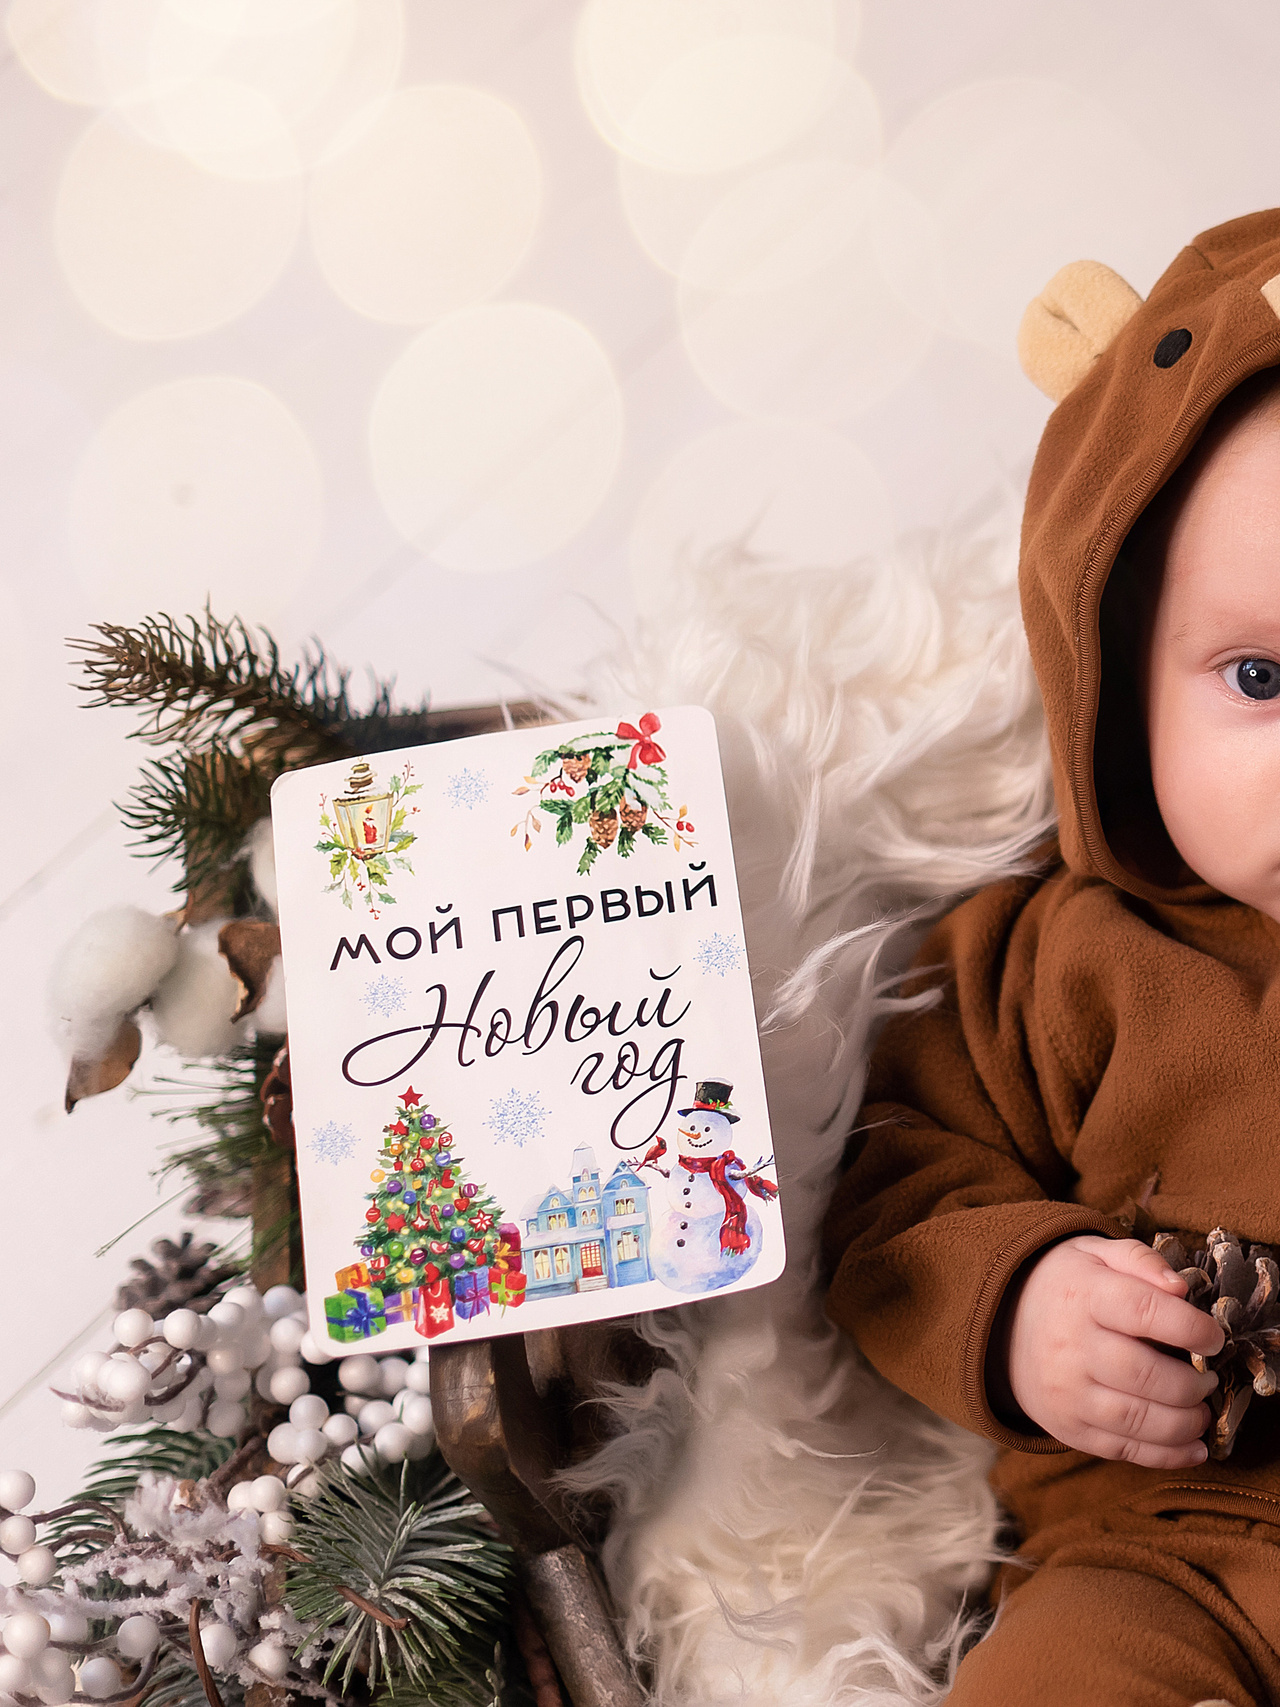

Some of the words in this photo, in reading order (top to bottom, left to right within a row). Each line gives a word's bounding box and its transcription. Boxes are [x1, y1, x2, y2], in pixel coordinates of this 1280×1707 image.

[330, 903, 463, 971] МОЙ
[491, 860, 718, 943] ПЕРВЫЙ
[341, 935, 692, 1087] Новый
[570, 1038, 688, 1151] год
